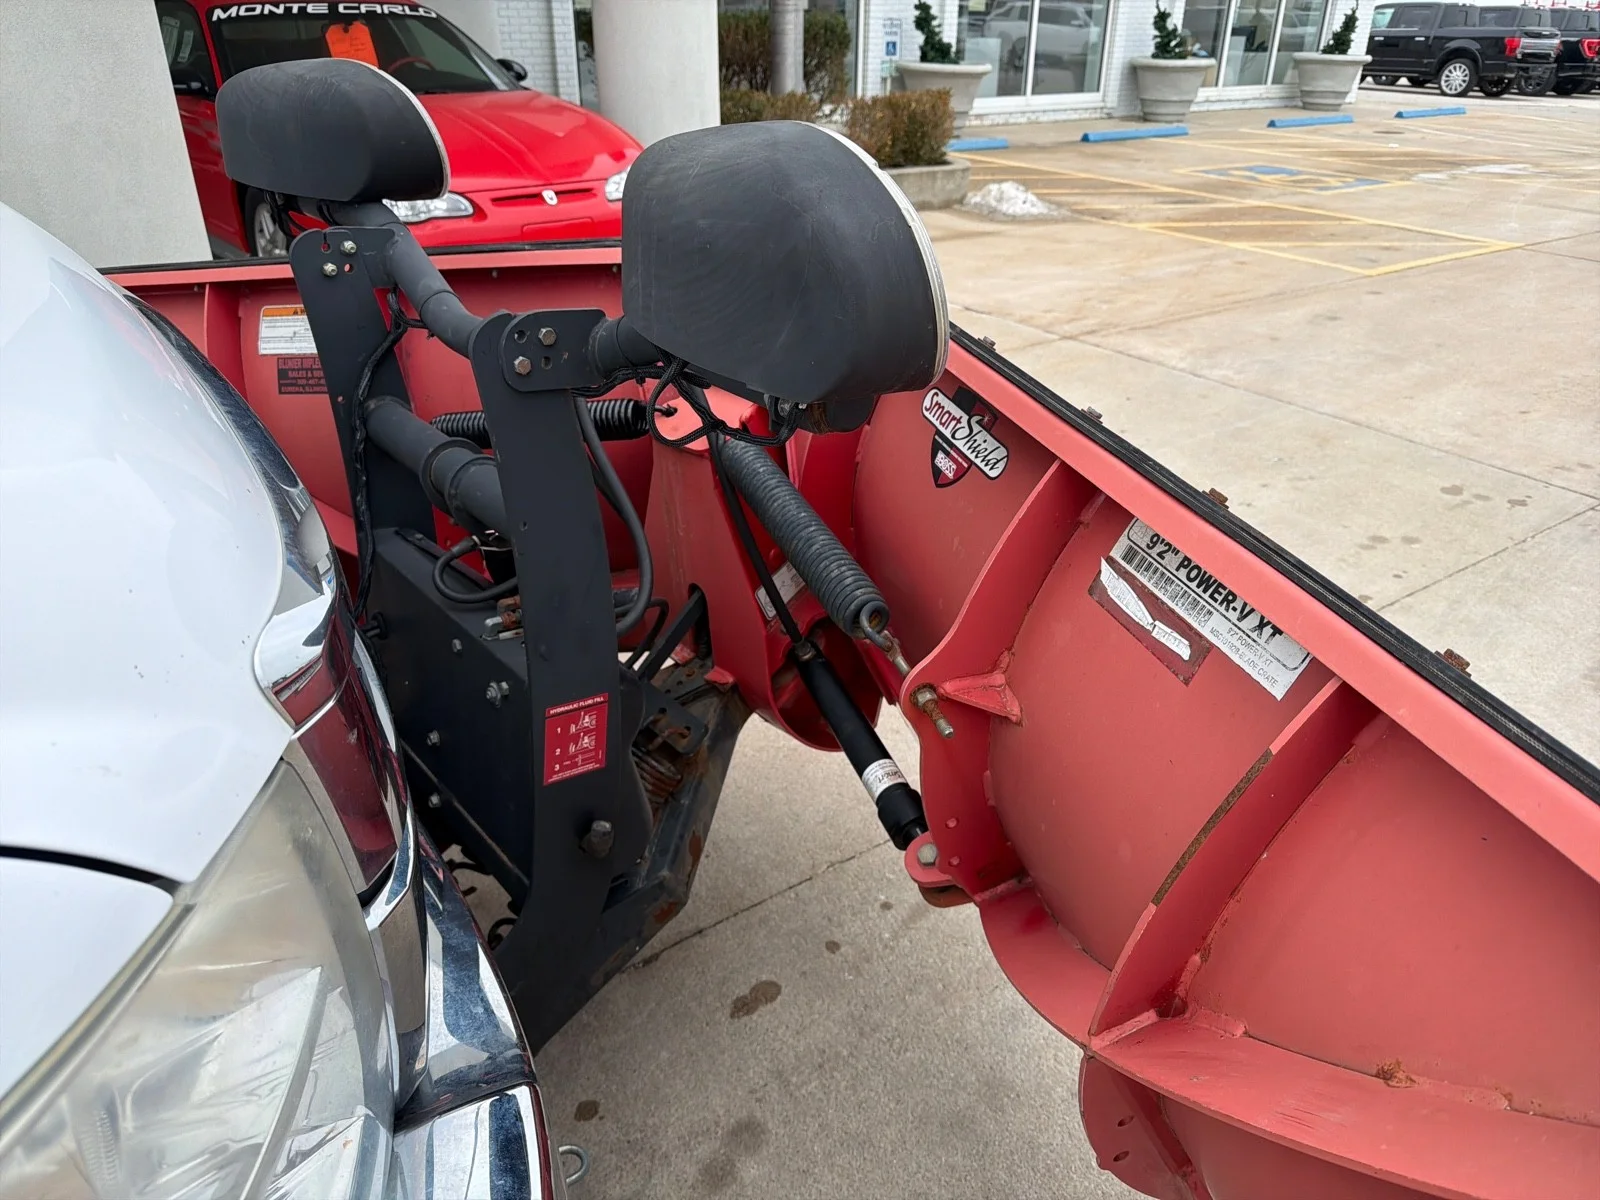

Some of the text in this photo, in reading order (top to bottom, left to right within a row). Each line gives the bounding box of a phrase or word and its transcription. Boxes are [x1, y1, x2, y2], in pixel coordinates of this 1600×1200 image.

[212, 2, 438, 21] MONTE CARLO
[924, 391, 963, 434] Smart
[951, 415, 1008, 472] Shield
[936, 452, 957, 479] BOSS
[1176, 557, 1254, 624] POWER-V
[1247, 611, 1284, 646] XT
[1257, 667, 1279, 688] CRATE
[550, 702, 579, 715] HYDRAULIC
[555, 748, 561, 756] 2
[554, 763, 560, 771] 3
